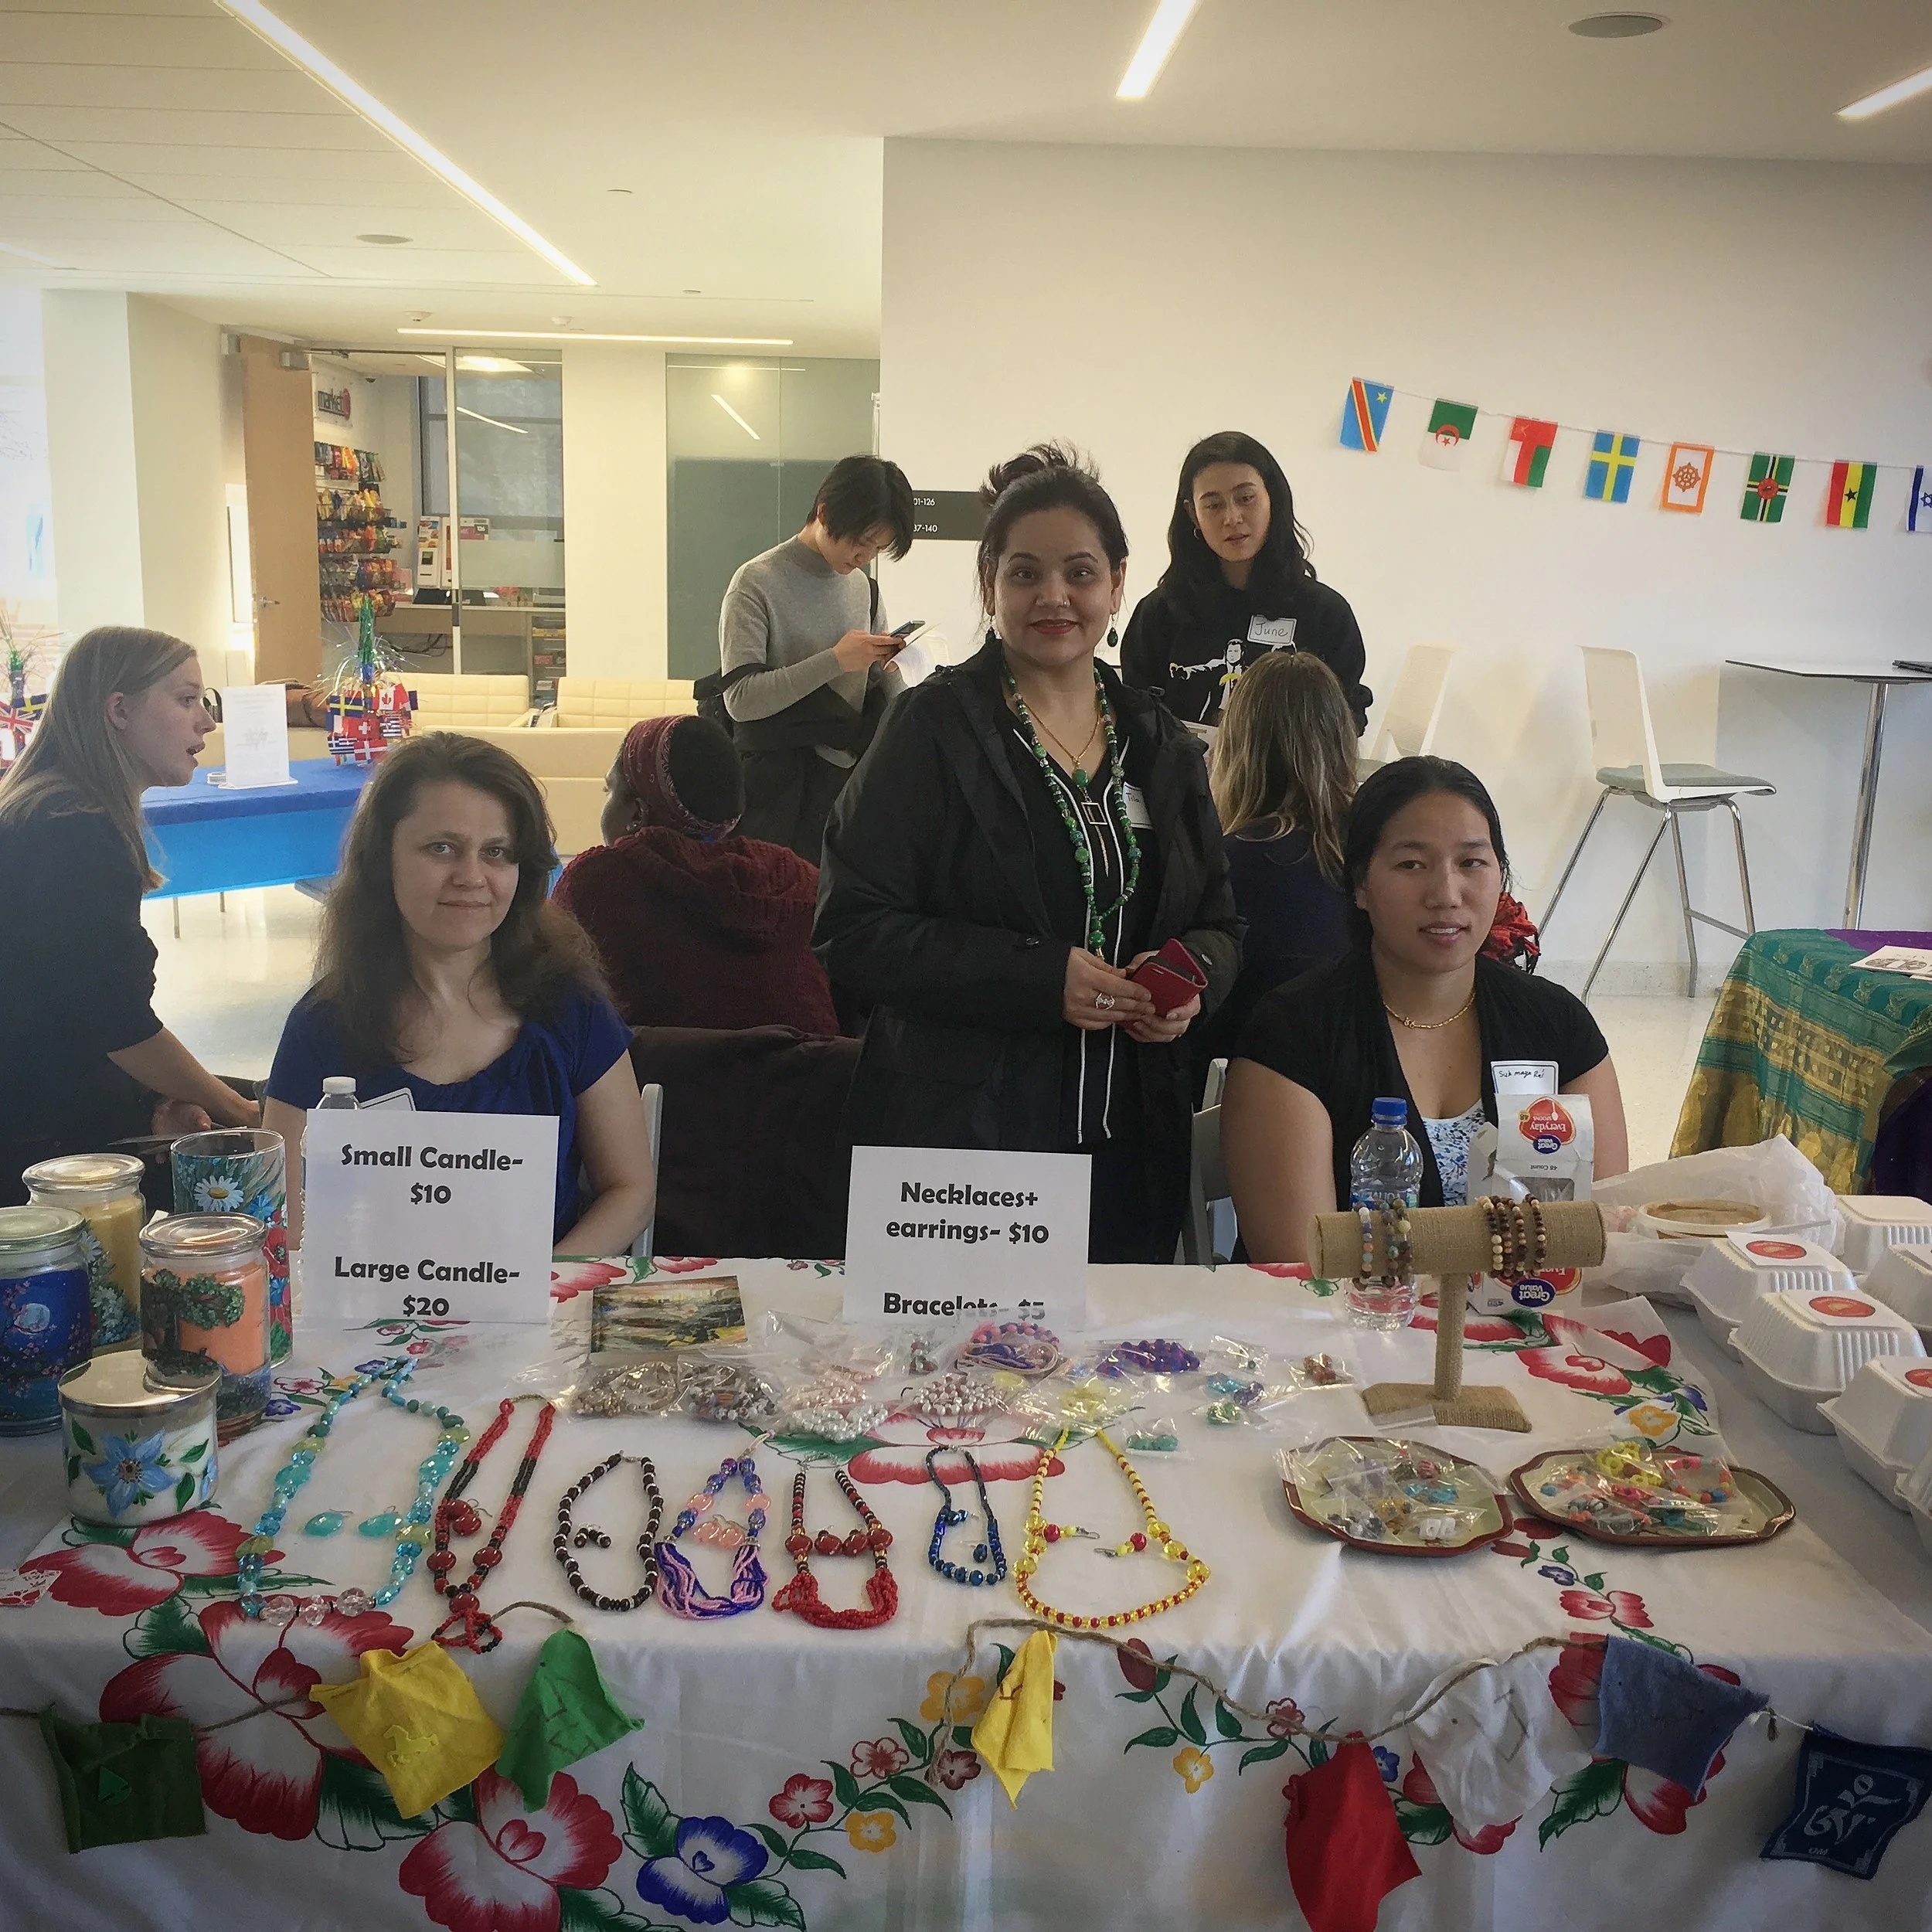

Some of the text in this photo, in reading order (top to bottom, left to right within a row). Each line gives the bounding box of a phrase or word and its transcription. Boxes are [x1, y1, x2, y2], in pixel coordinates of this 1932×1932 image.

[1255, 621, 1288, 637] June
[1529, 1121, 1566, 1133] Everyday
[1537, 1141, 1558, 1150] Great
[341, 1143, 523, 1171] Small Candle-
[410, 1182, 452, 1205] $10
[900, 1182, 1039, 1207] Necklaces+
[886, 1219, 1049, 1244] earrings- $10
[335, 1256, 520, 1284] Large Candle-
[403, 1294, 450, 1317] $20
[1519, 1290, 1550, 1302] Great
[1018, 1299, 1046, 1320] $5
[1808, 1847, 1829, 1855] OM
